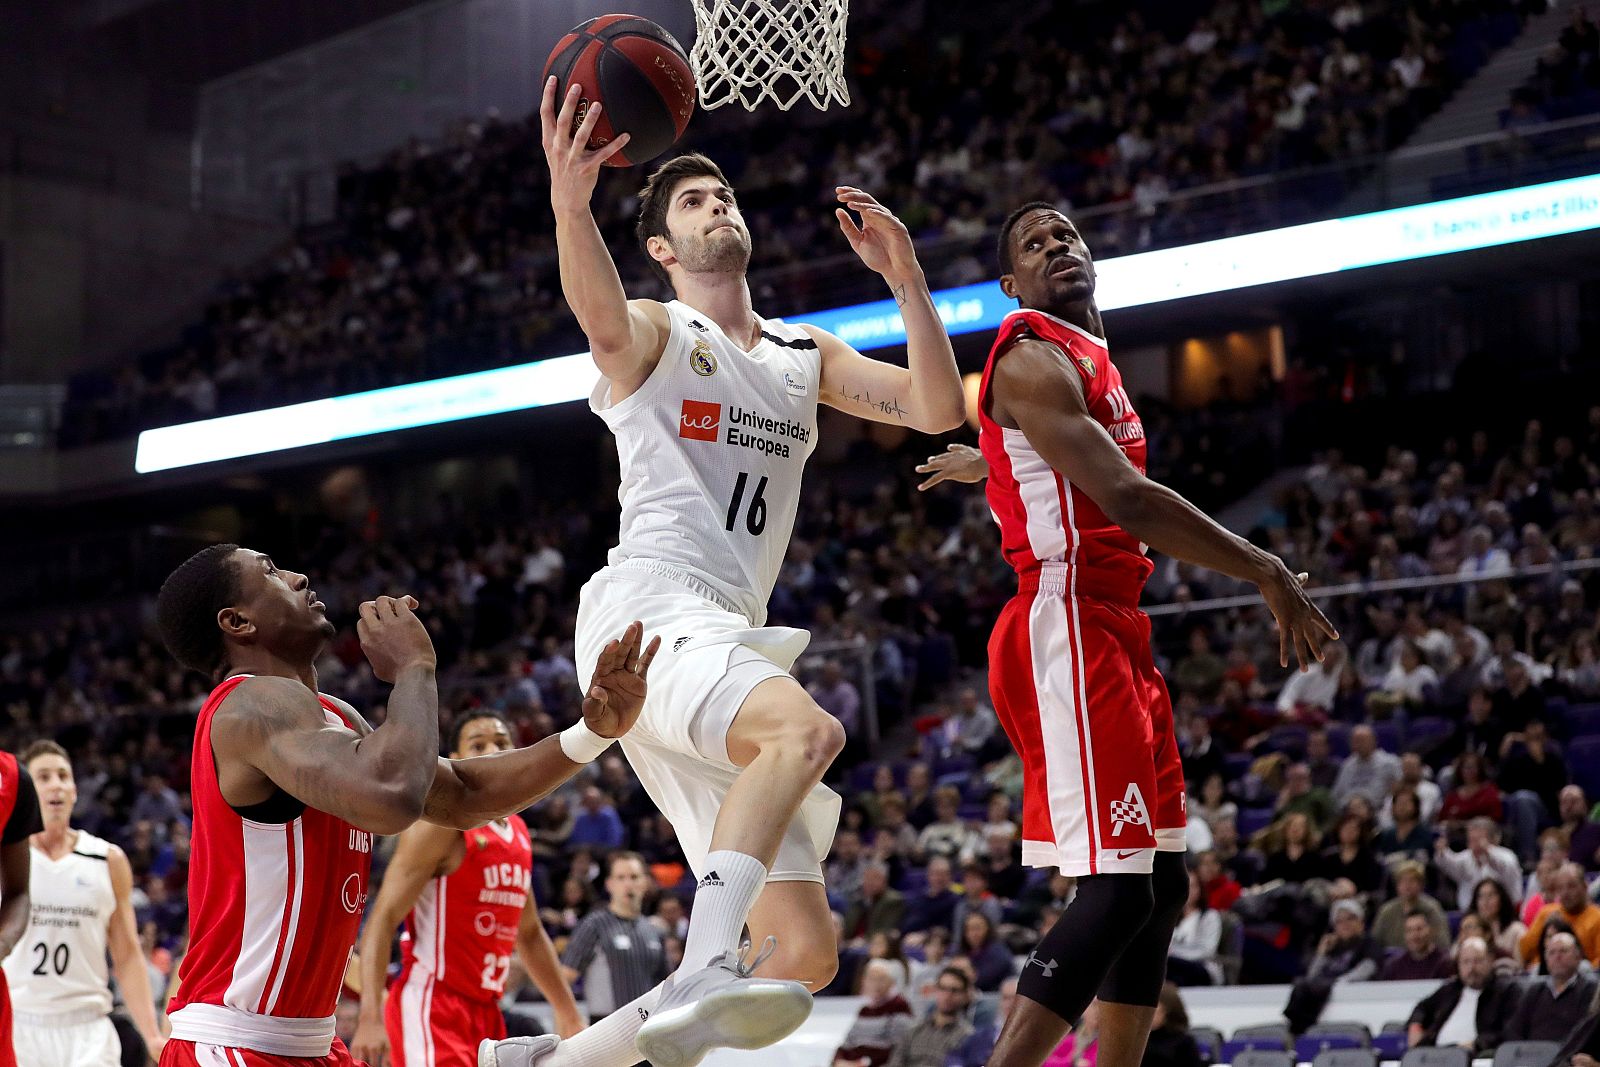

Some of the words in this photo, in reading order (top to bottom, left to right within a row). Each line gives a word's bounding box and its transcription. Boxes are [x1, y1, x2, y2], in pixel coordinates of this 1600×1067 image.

[726, 428, 790, 458] Europea
[729, 406, 811, 445] Universidad
[725, 471, 769, 536] 16
[32, 942, 69, 976] 20
